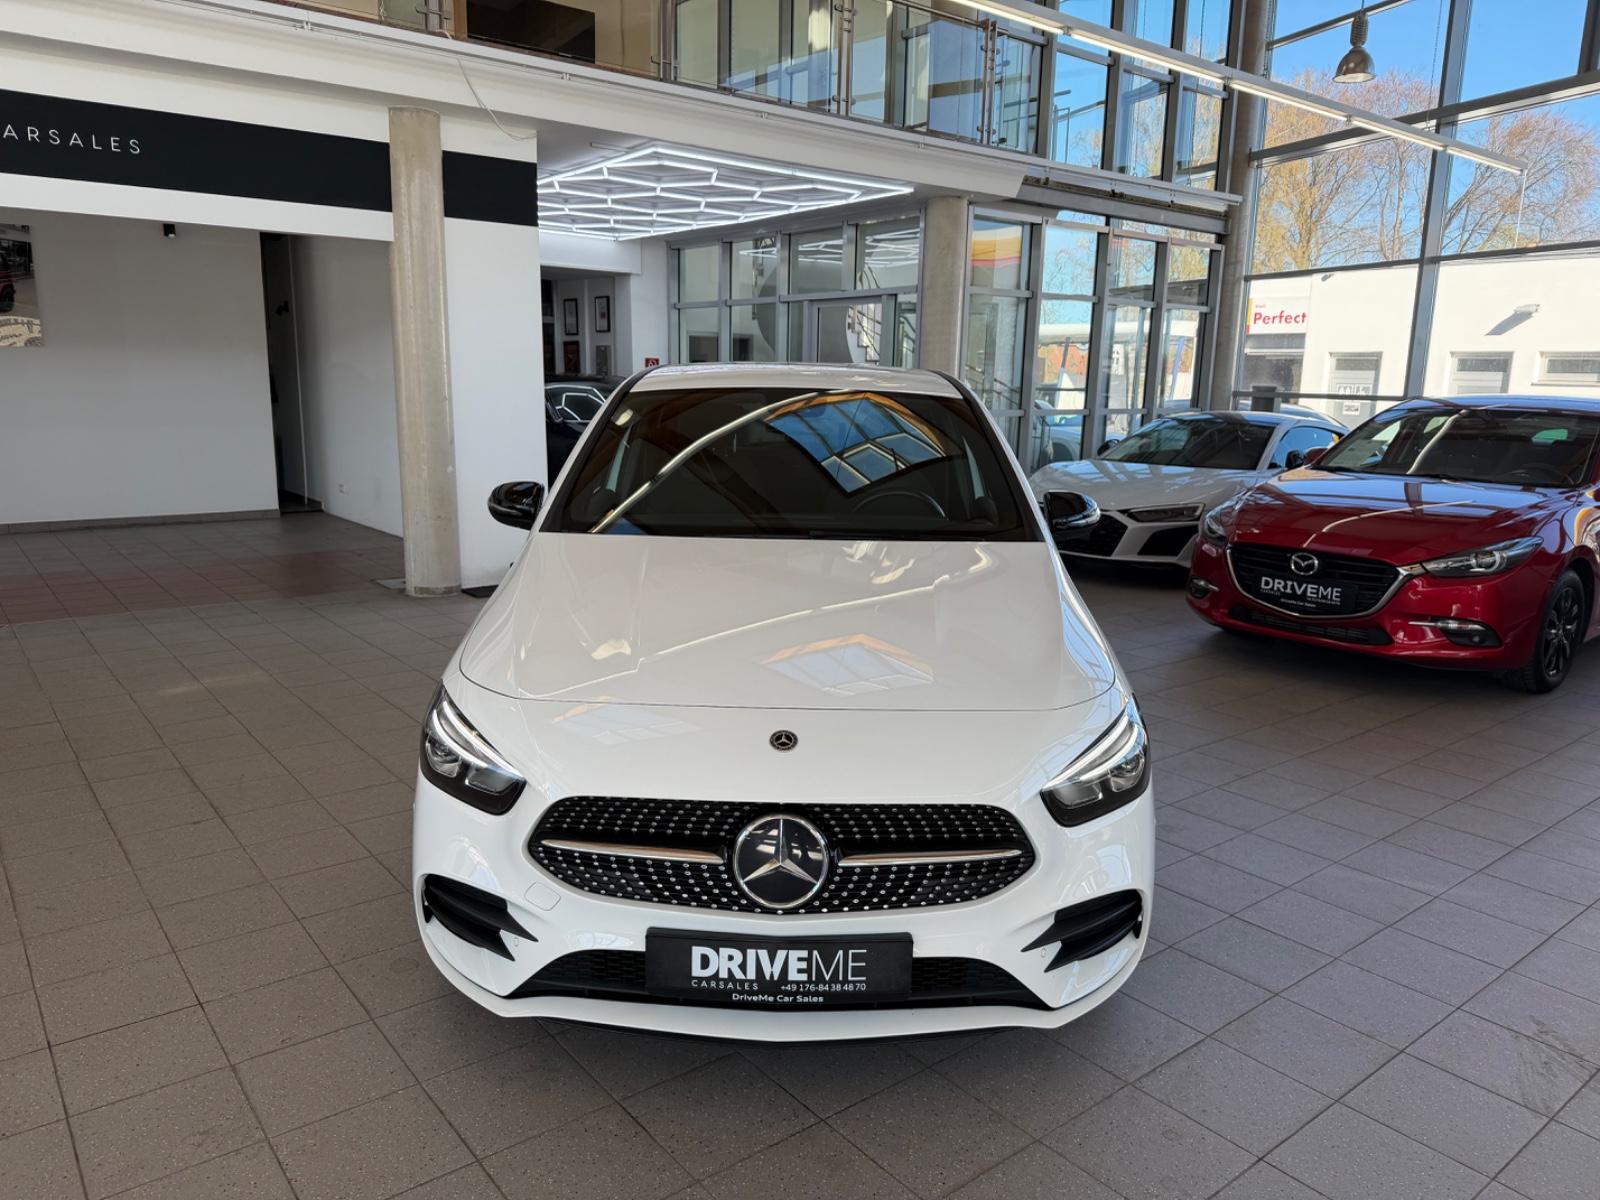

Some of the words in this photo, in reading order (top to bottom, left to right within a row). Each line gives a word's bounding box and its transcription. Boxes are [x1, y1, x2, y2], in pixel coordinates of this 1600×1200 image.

[1253, 310, 1307, 325] Perfect
[1260, 576, 1342, 601] DRIVEME
[691, 945, 868, 982] DRIVEME
[691, 979, 759, 991] CARSALES
[732, 993, 775, 1002] DriveMe
[776, 994, 795, 1003] Car
[796, 995, 825, 1003] Sales
